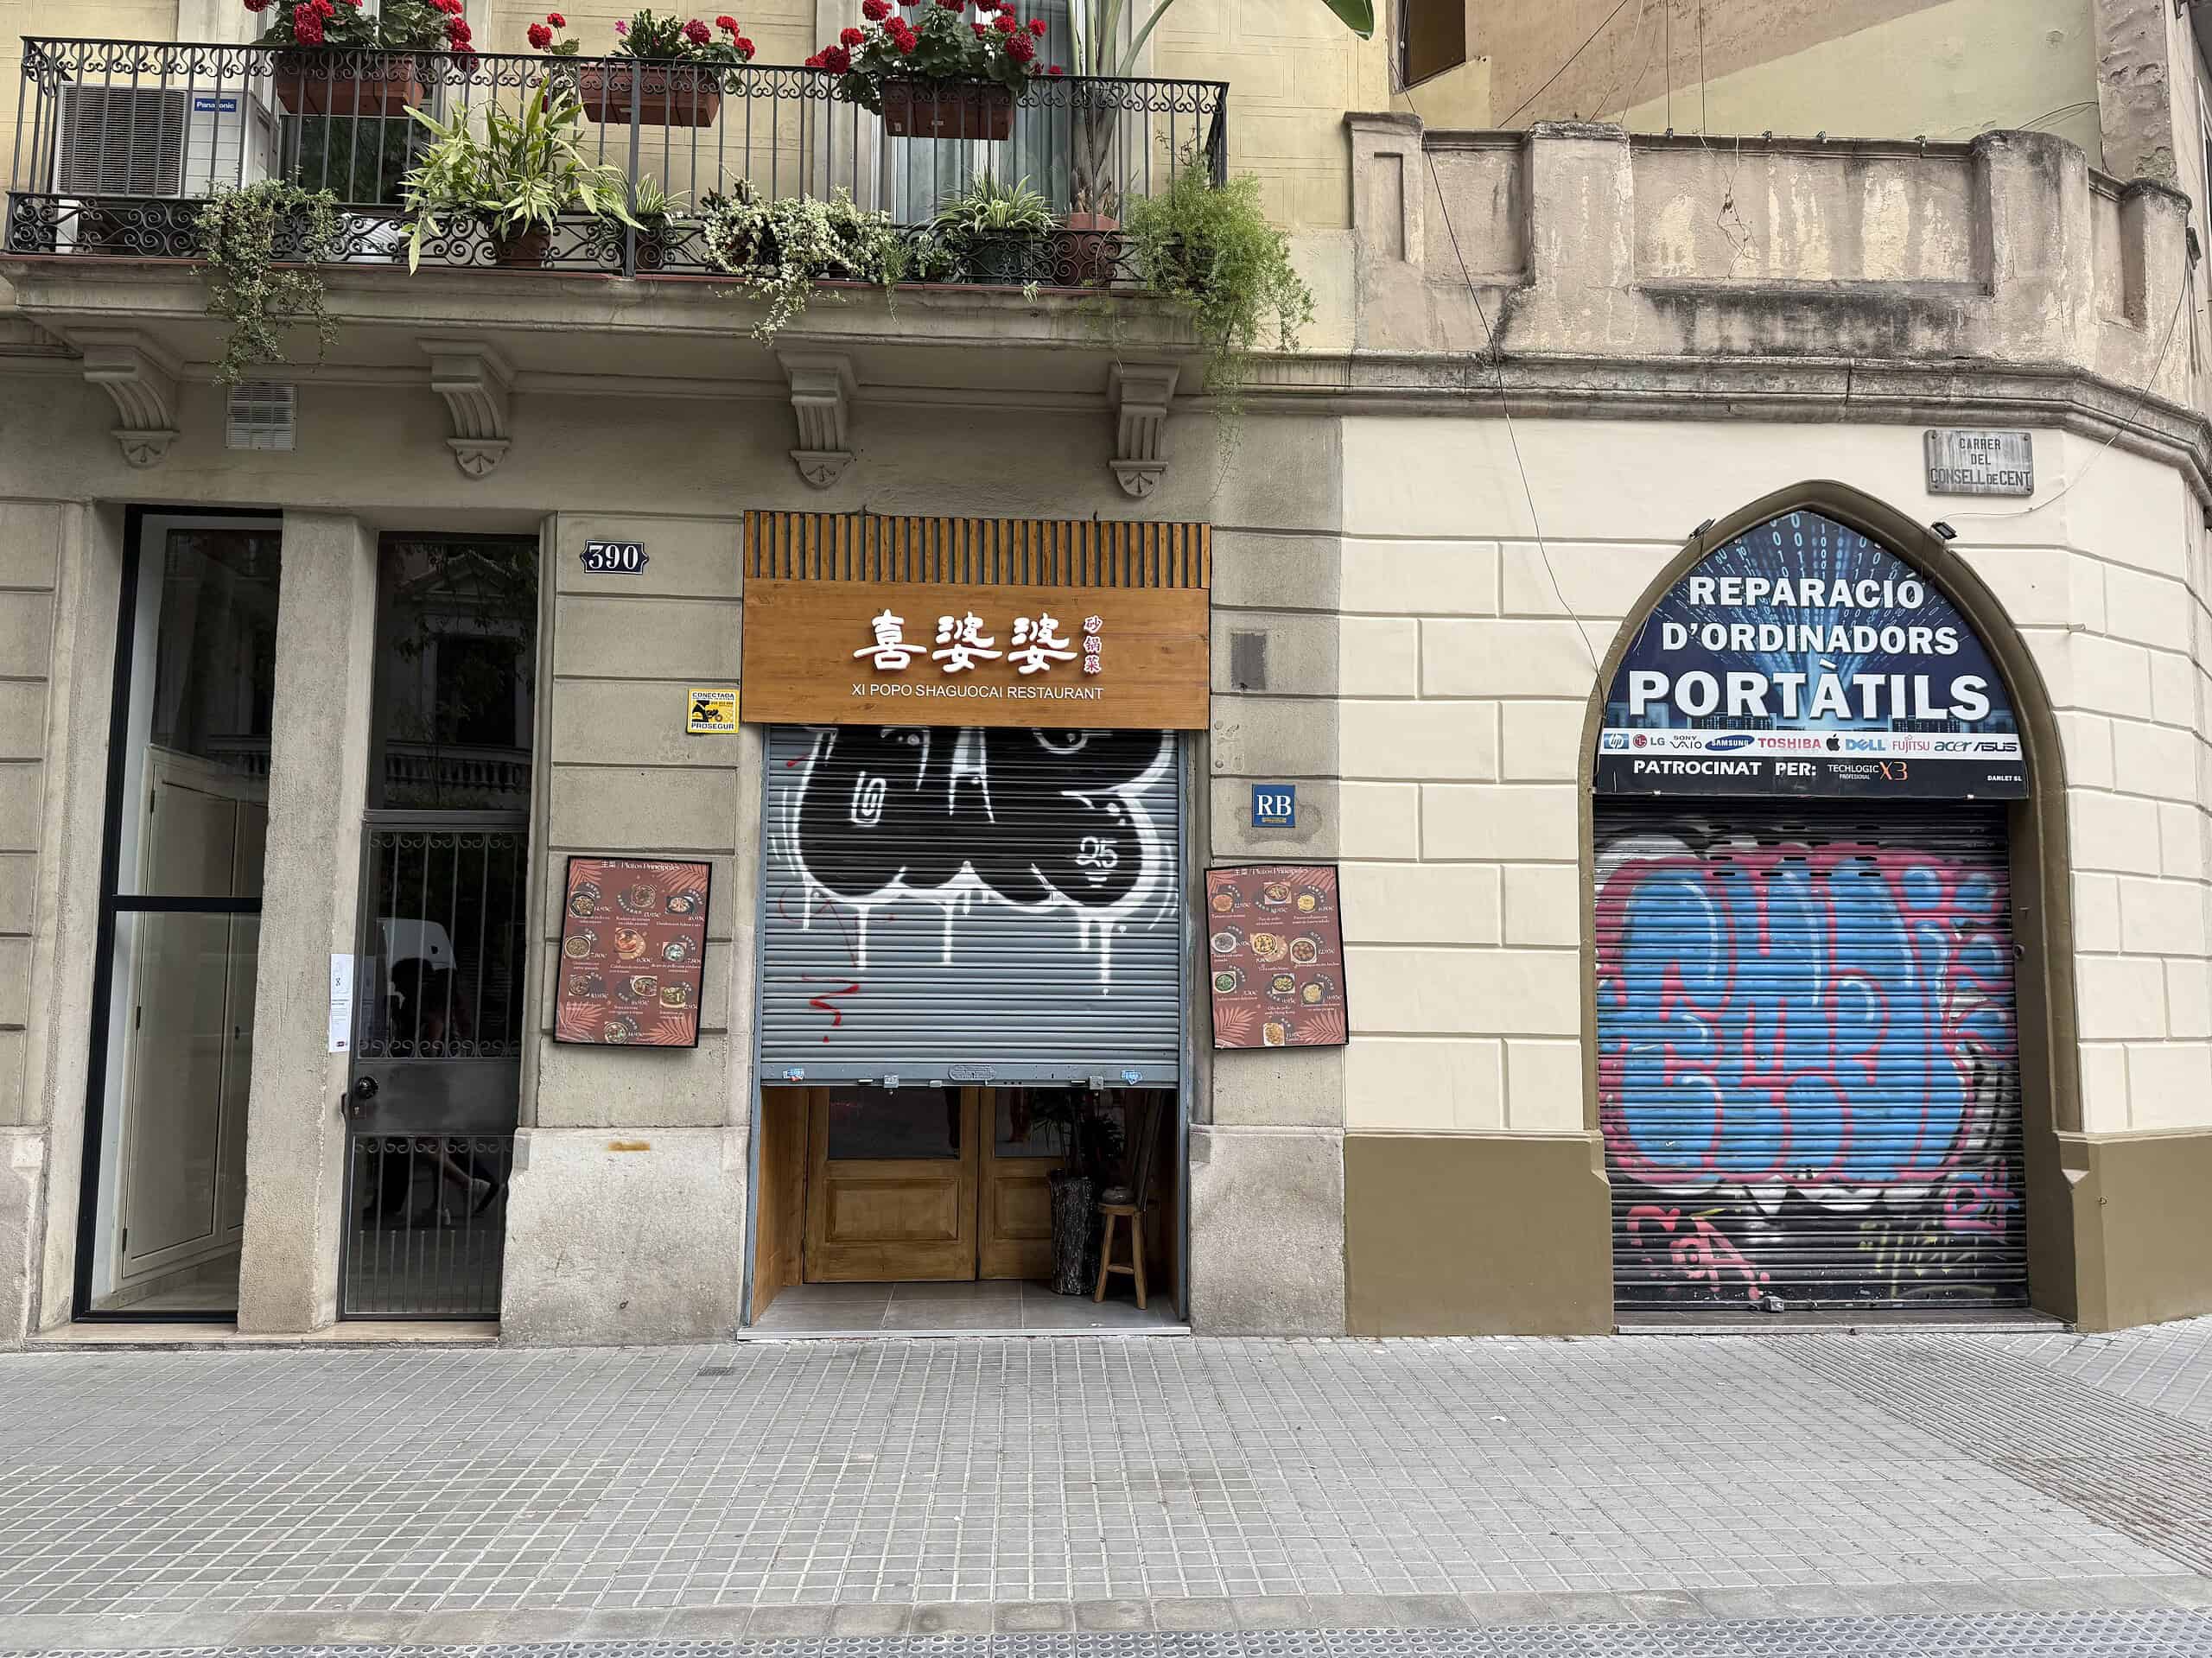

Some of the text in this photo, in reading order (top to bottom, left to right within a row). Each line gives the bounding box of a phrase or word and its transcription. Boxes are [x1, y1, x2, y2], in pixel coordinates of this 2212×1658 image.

[1959, 438, 2001, 449] CARRER
[1970, 454, 1991, 465] DEL
[1930, 468, 1986, 485] CONSELL
[1999, 471, 2031, 486] CENT
[588, 545, 639, 569] 390
[1689, 572, 1924, 609] REPARACIÓ
[853, 608, 1077, 676] 喜婆婆
[1084, 614, 1103, 674] 砂锅菜
[1662, 621, 1960, 655] D'ORDINADORS
[851, 683, 1104, 700] XI POPO SHAGUOCAI RESTAURANT
[1629, 658, 1991, 721] PORTÀTILS
[1650, 737, 1665, 746] LG
[1711, 739, 1749, 747] SAMSUNG
[1758, 738, 1821, 749] TOSHIBA
[1846, 739, 1887, 752] DELL
[1892, 738, 1930, 753] FUJITSU
[1934, 741, 1973, 752] acer
[1974, 741, 2018, 753] ASUS
[1633, 759, 1817, 777] PATROCINAT PER:
[1827, 761, 1909, 781] TECHLOGIC X3
[1256, 794, 1293, 816] RB
